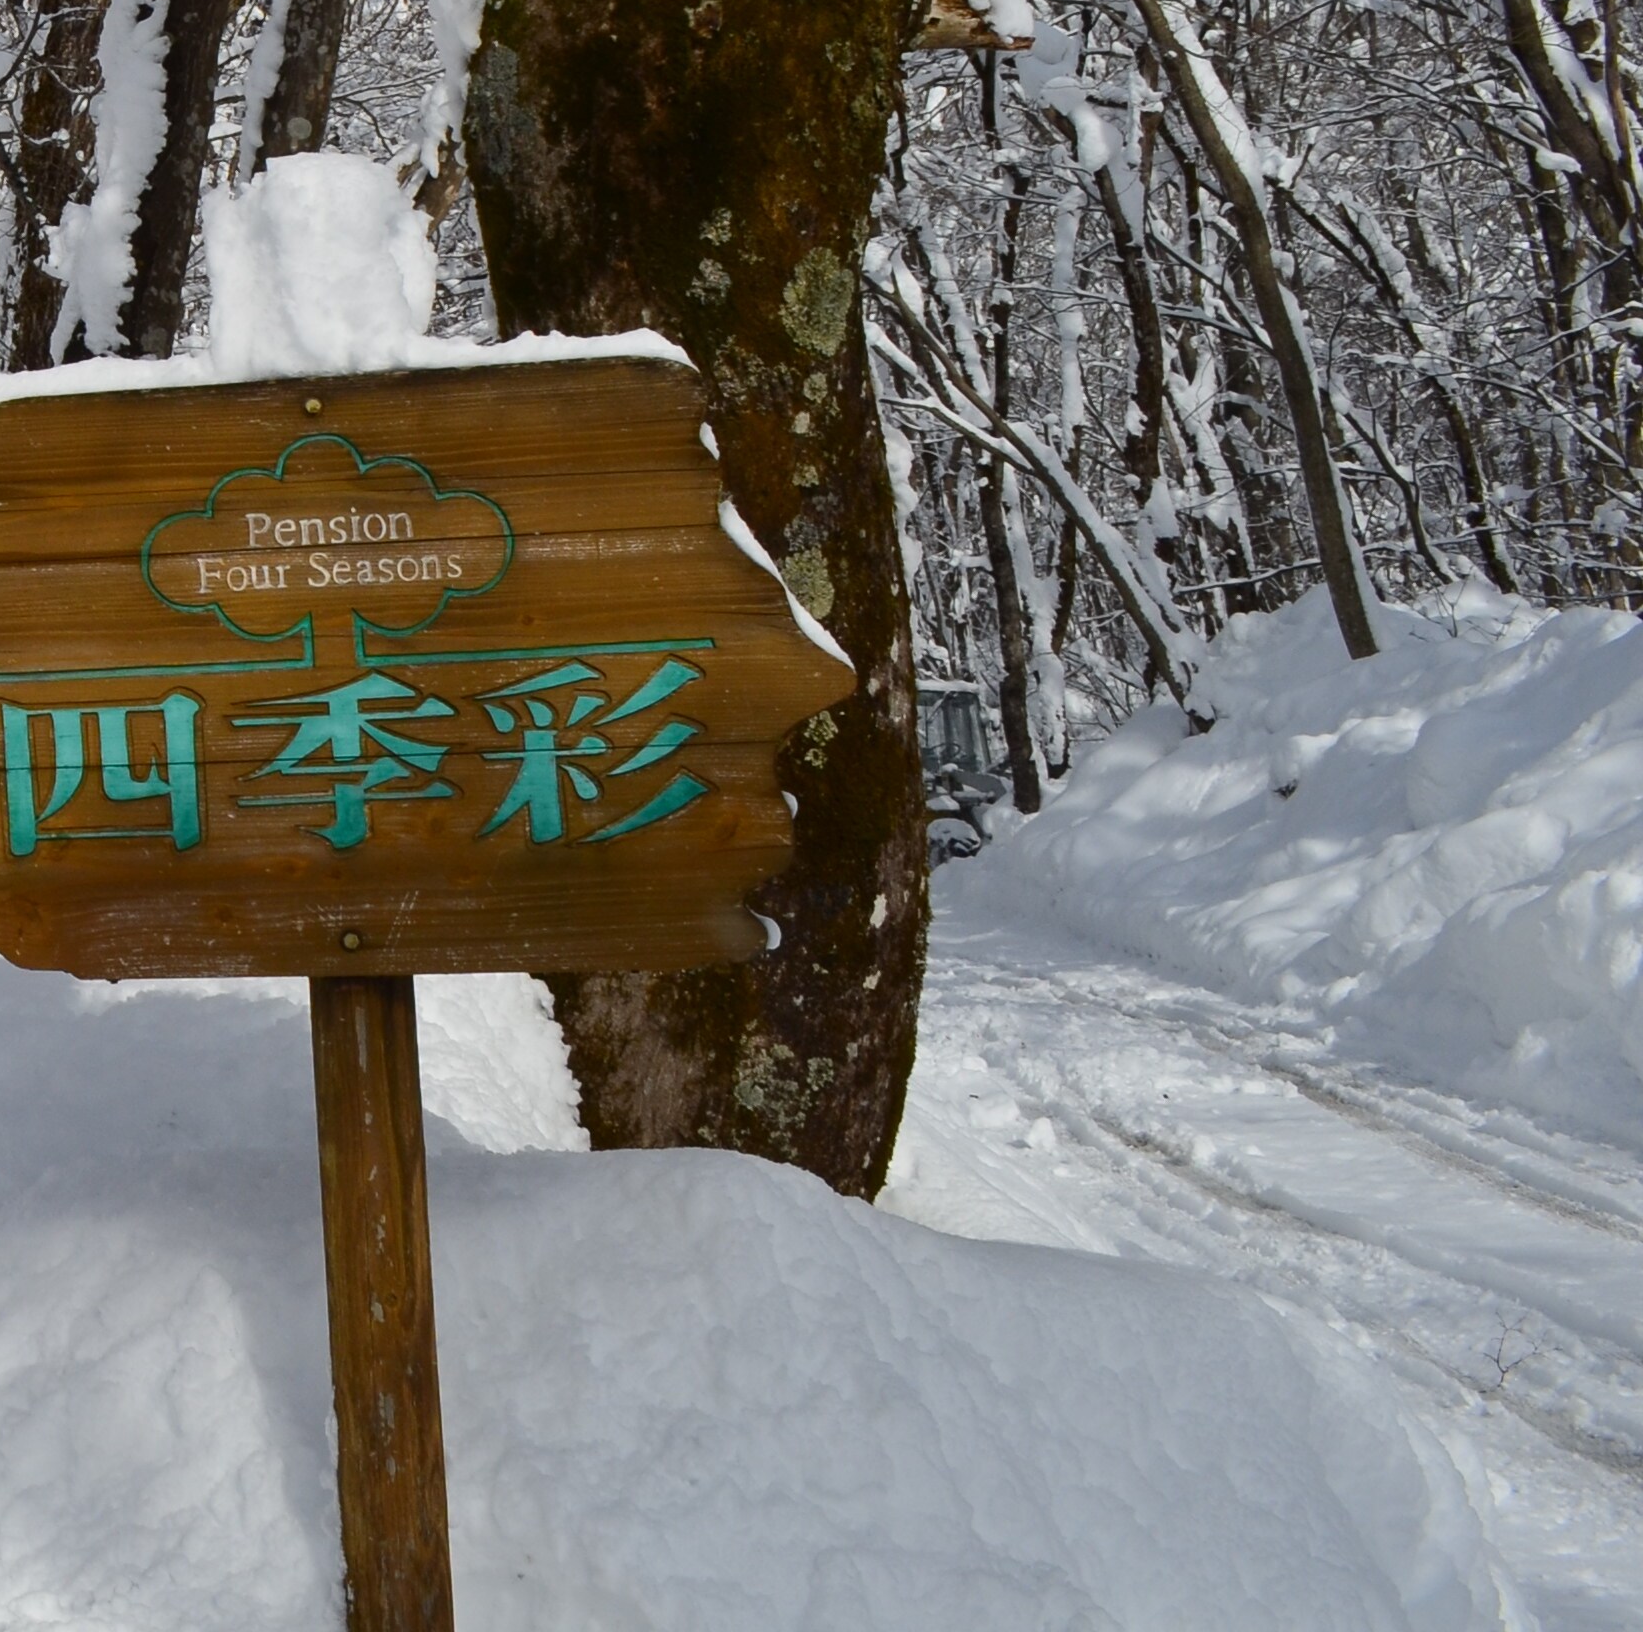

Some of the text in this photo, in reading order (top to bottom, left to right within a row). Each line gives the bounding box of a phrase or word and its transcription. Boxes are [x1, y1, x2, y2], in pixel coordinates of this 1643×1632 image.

[244, 506, 415, 548] Pension
[196, 551, 464, 594] Four Seasons
[1, 659, 711, 857] 四季彩
